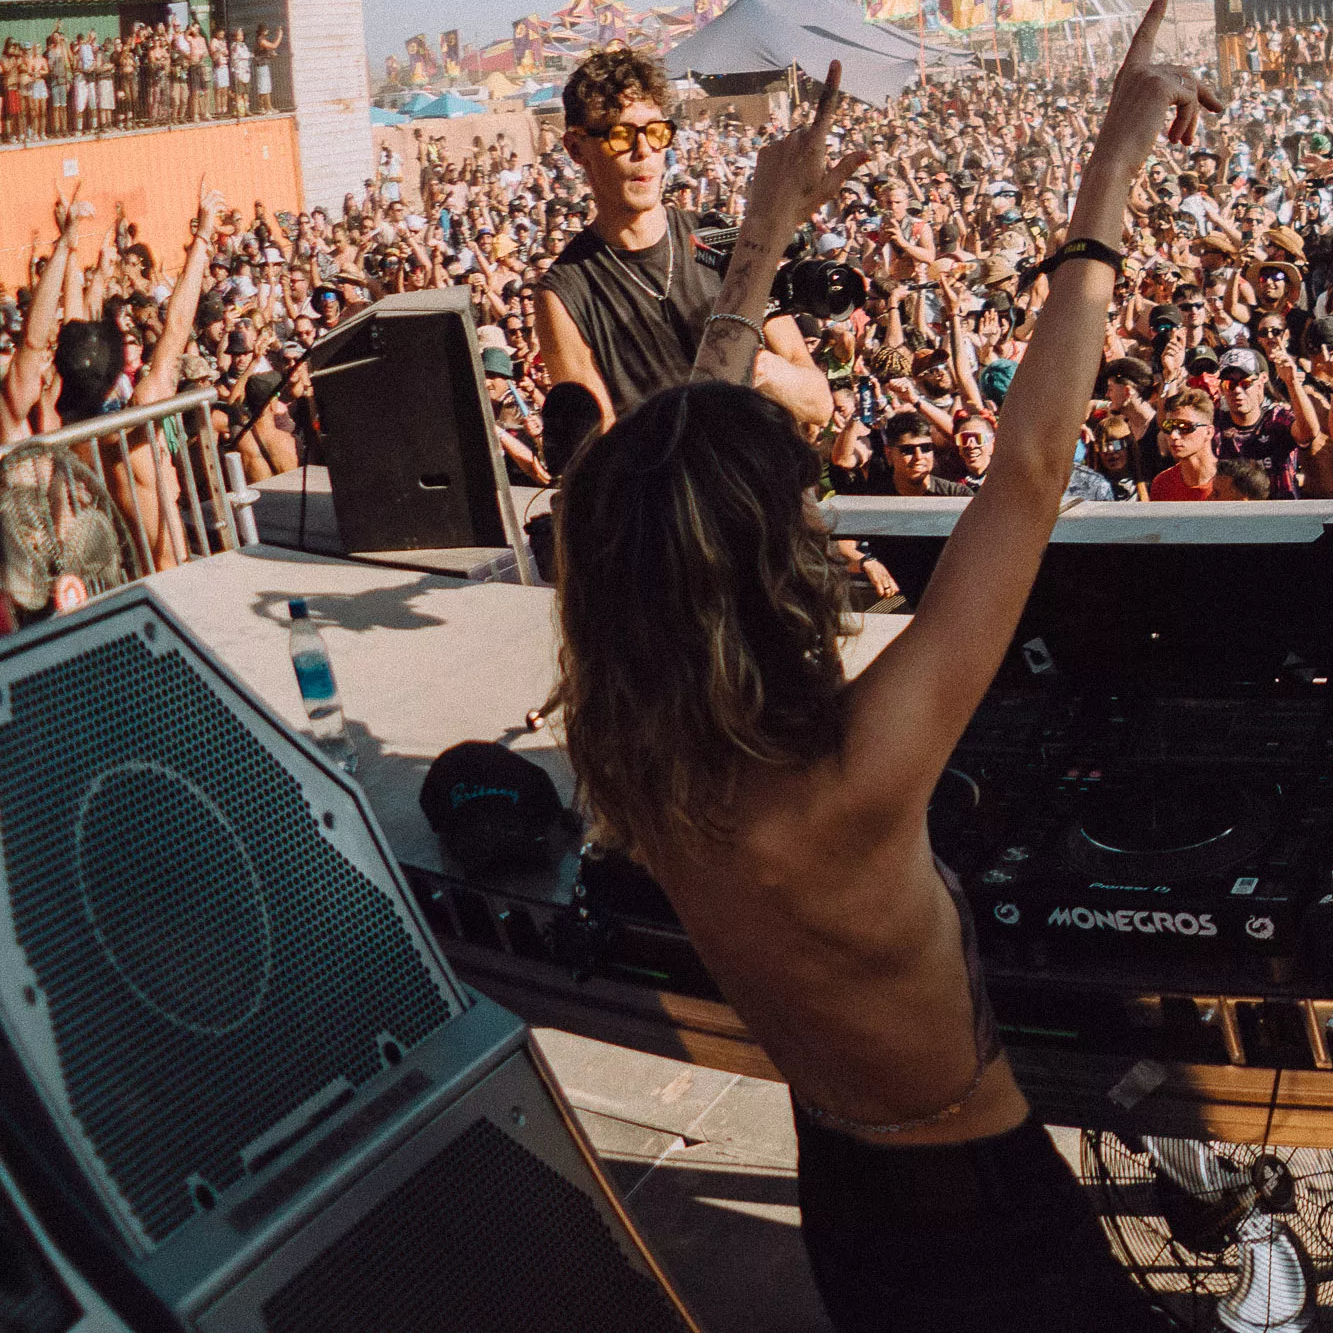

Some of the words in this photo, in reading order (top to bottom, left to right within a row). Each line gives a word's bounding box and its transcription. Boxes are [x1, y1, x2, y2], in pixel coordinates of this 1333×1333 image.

[697, 249, 716, 266] NIN
[1089, 881, 1149, 892] Pioneer
[1047, 905, 1217, 936] MONEGROS
